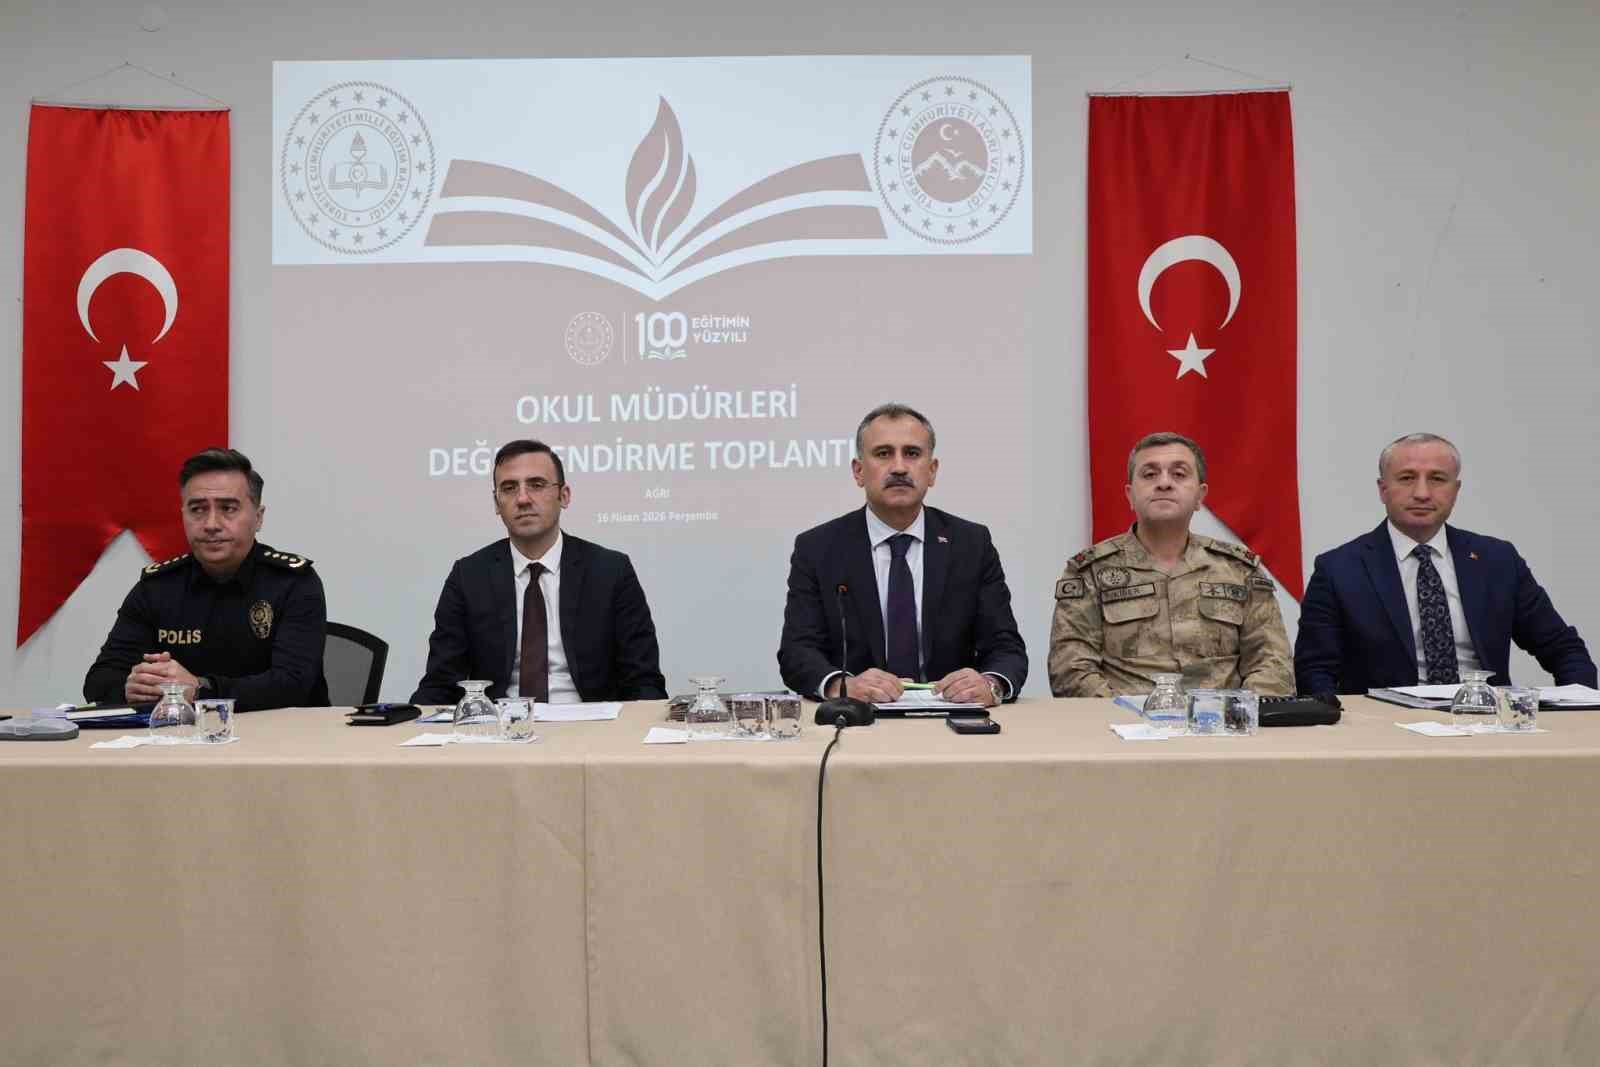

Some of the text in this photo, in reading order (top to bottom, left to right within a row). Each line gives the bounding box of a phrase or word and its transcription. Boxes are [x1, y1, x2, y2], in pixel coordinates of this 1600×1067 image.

[691, 314, 751, 328] EĞİTİMİN
[635, 311, 688, 360] 100
[691, 329, 748, 344] YÜZYILI
[516, 383, 797, 424] OKUL MÜDÜRLERİ
[158, 629, 202, 645] POLİS
